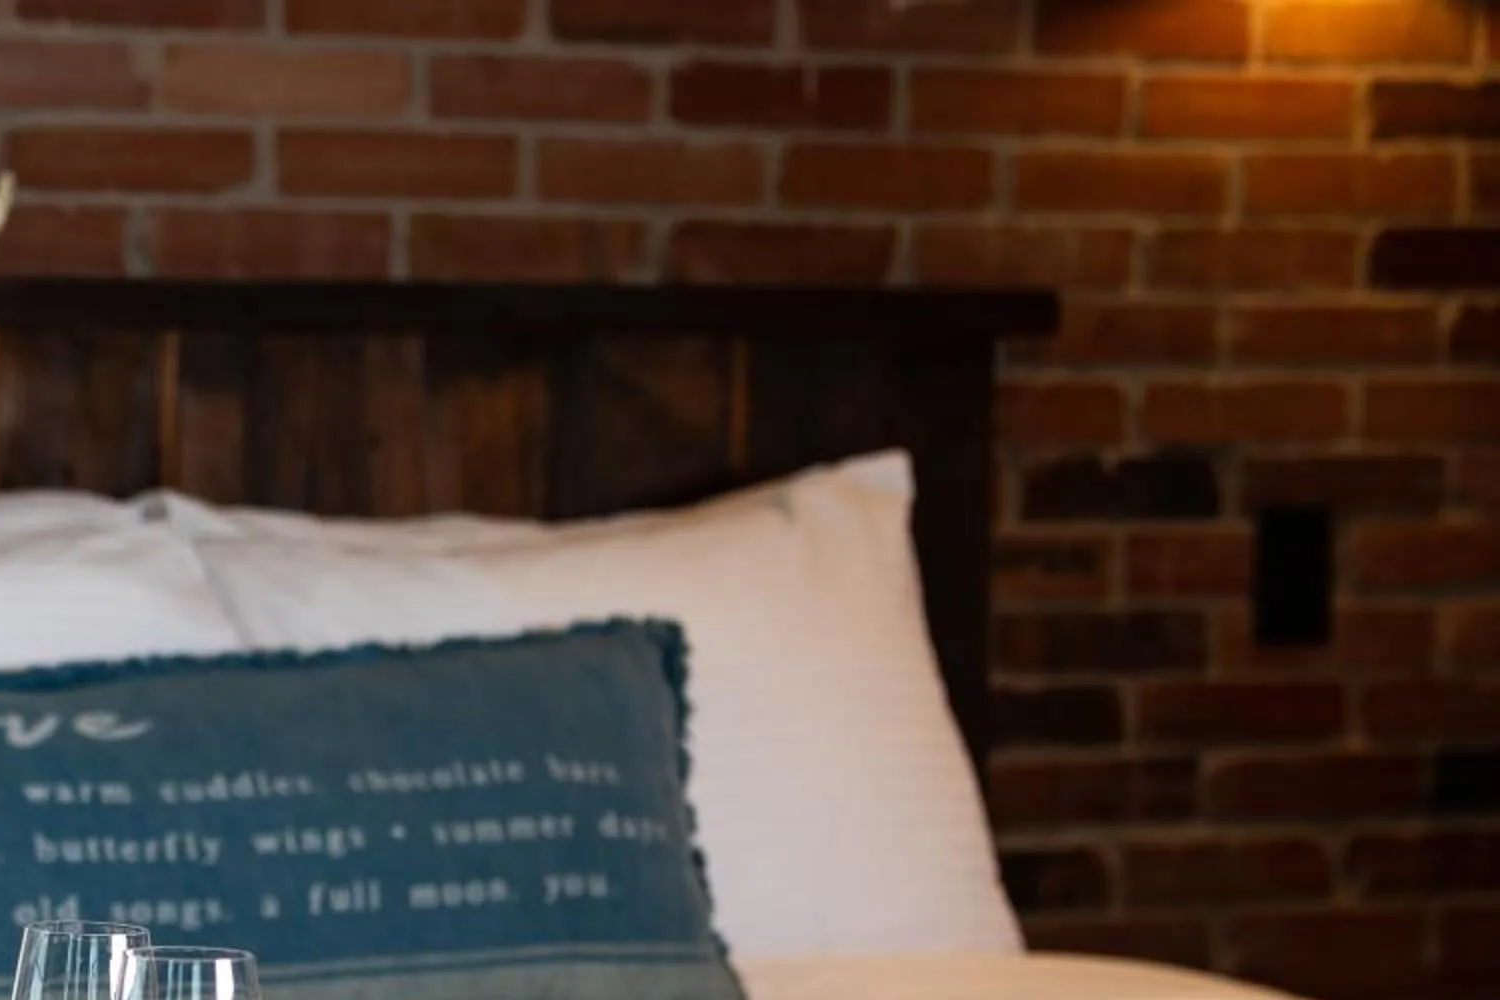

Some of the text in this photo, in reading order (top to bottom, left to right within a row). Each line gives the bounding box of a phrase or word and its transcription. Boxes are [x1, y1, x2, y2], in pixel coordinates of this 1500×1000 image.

[20, 780, 133, 804] warm
[346, 758, 527, 793] chocolate
[31, 829, 223, 866] butterfly
[251, 825, 367, 859] wings
[430, 811, 575, 846] summer
[11, 893, 80, 929] old
[259, 893, 281, 919] a
[308, 880, 382, 917] full
